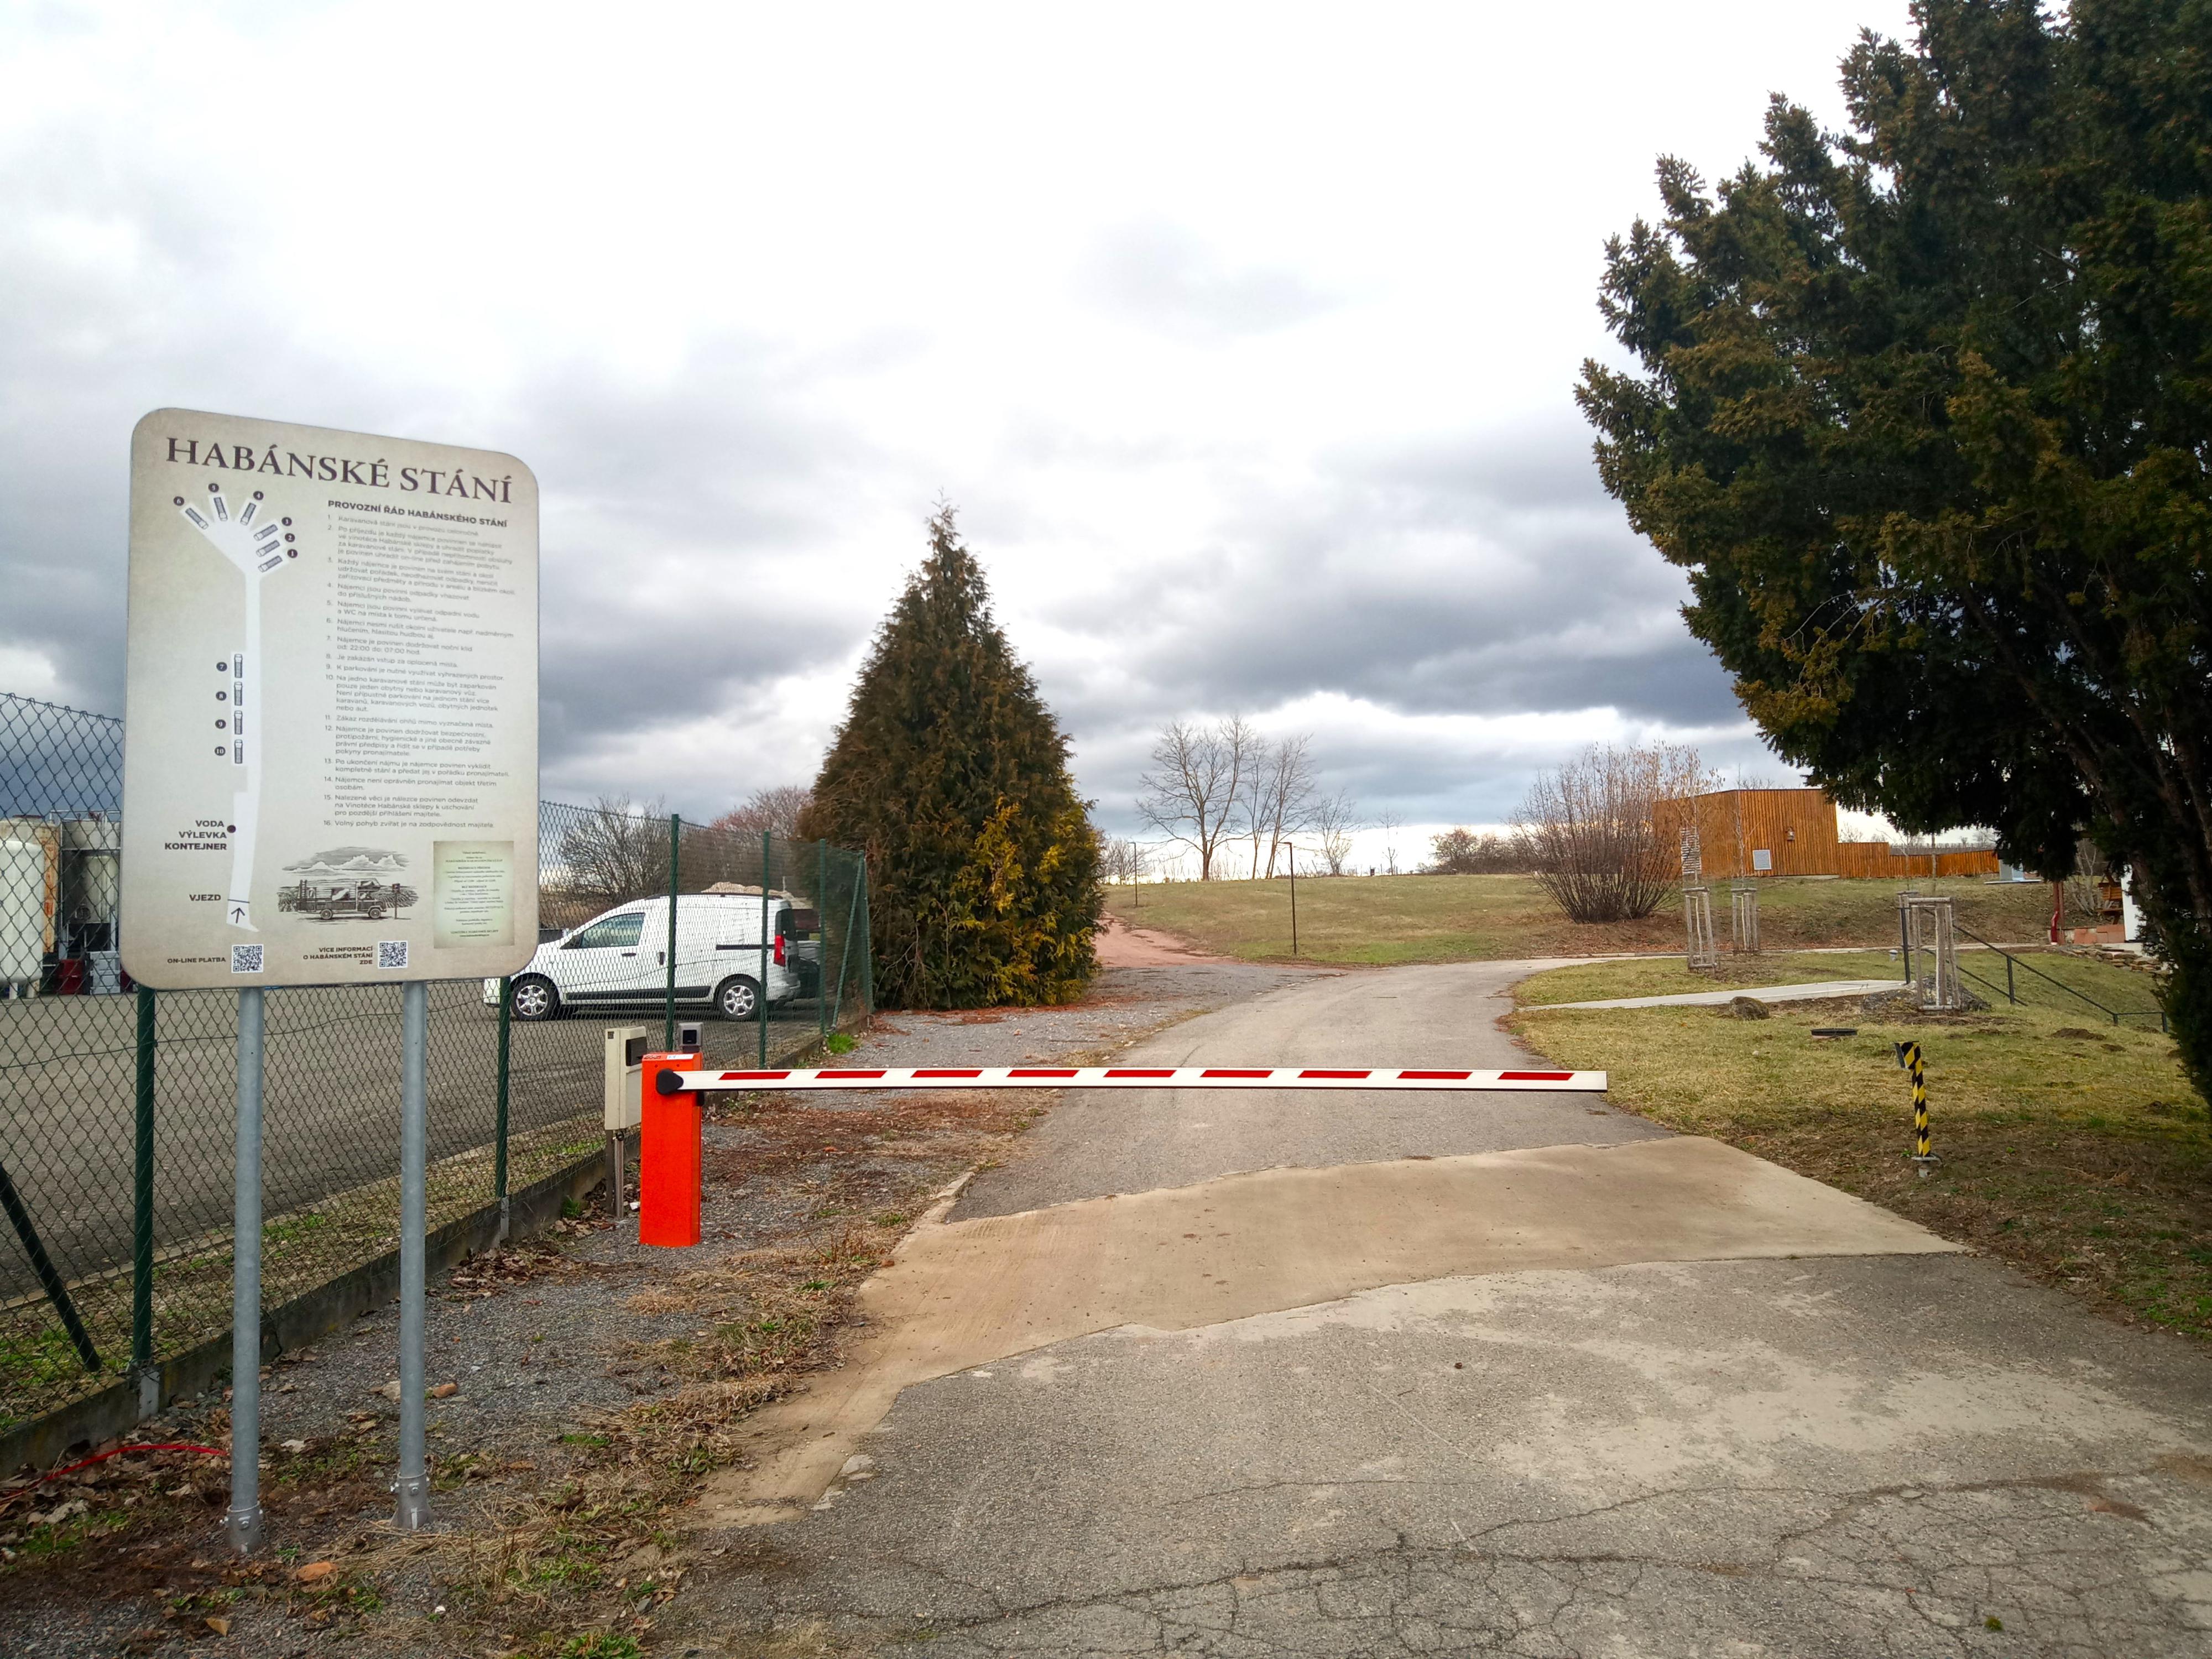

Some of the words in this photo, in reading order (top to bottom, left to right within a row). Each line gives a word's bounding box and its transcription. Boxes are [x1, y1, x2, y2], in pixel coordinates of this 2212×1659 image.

[166, 437, 390, 488] HABÁNSKÉ
[400, 467, 512, 504] STÁNÍ
[328, 500, 382, 513] PROVOZNÍ
[383, 505, 405, 515] ŘÁD
[408, 509, 477, 524] HABÁNSKÉHO
[479, 518, 507, 528] STÁNÍ
[335, 748, 362, 756] pokyny
[179, 830, 227, 838] VÝLEVKA
